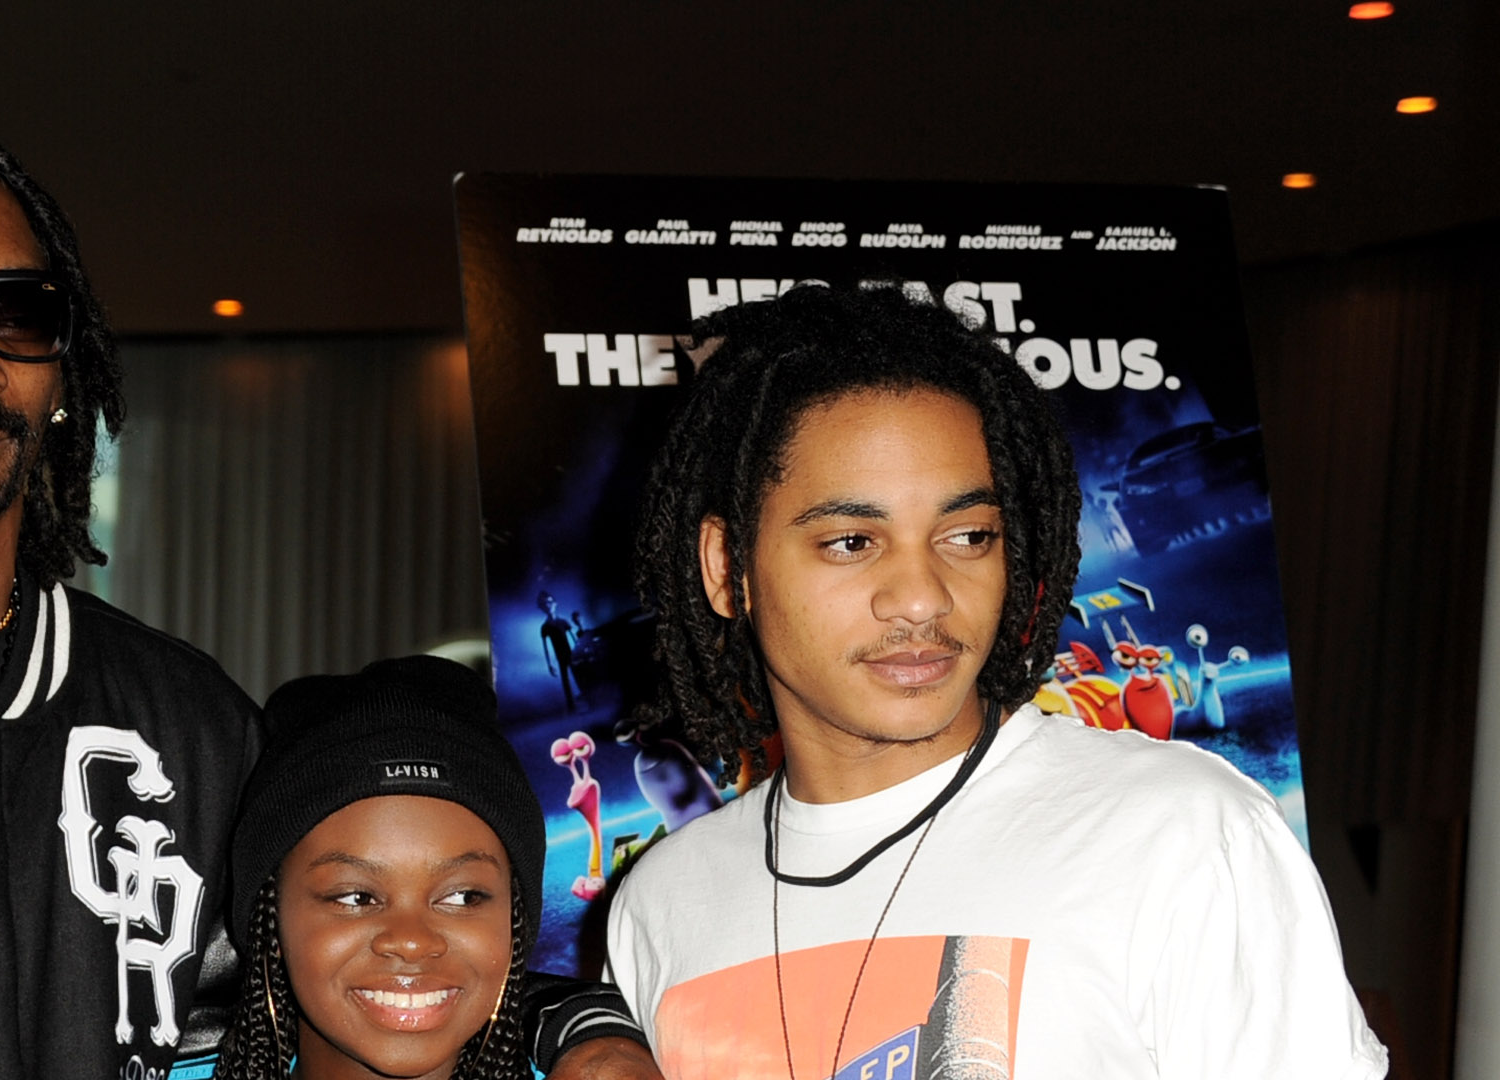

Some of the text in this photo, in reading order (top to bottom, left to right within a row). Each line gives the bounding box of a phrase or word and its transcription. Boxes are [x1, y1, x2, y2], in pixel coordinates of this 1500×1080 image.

[550, 218, 586, 229] RYAN
[657, 220, 689, 230] PAUL
[730, 221, 783, 231] MICHAEL
[800, 222, 845, 232] SNOOP
[887, 223, 923, 234] MAYA
[985, 225, 1041, 235] MICHELLE
[1105, 227, 1155, 237] SAMUEL
[516, 228, 1176, 251] REYNOLDS GIAMATTI PEÑA DOGG RUDOLPH RODRIGUEZ AND JACKSON
[385, 765, 439, 778] LAVISH
